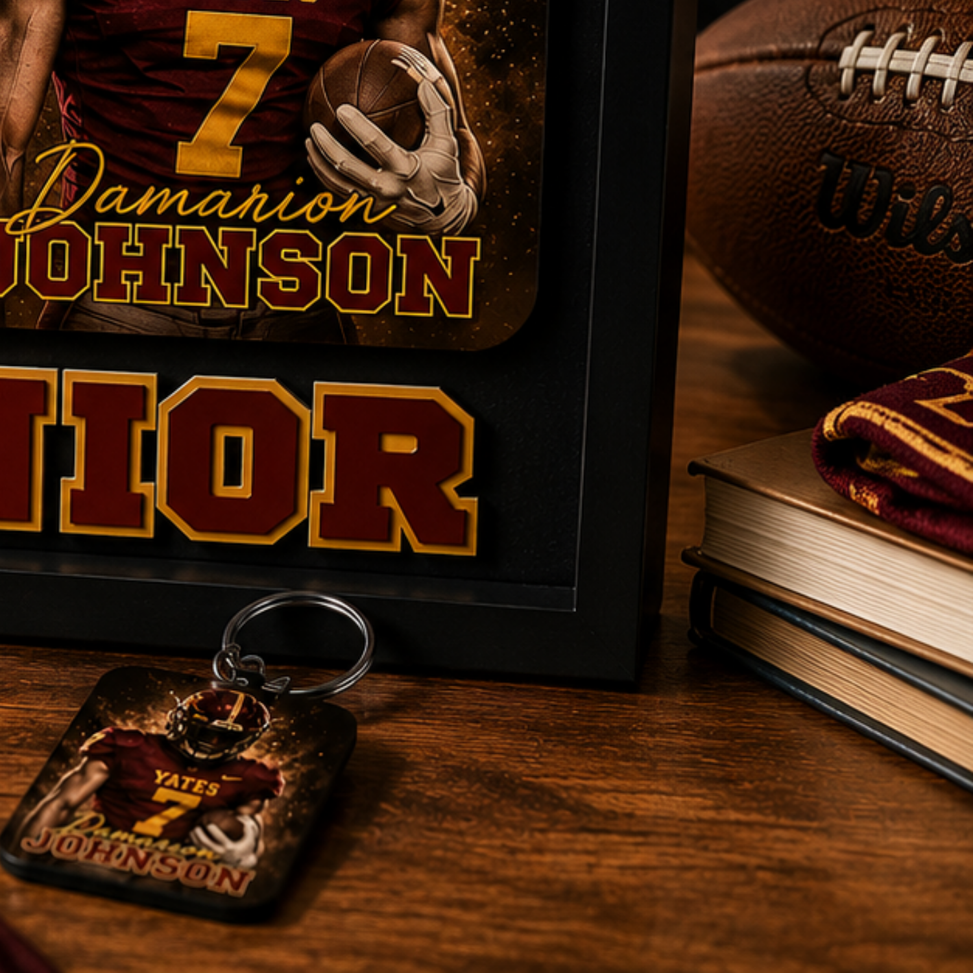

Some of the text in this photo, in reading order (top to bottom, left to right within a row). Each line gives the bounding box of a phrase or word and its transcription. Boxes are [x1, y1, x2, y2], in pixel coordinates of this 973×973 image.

[175, 10, 293, 178] 7
[5, 139, 397, 236] Damarion
[132, 787, 202, 837] 7
[154, 769, 221, 797] YATES
[20, 826, 257, 898] JOHNSON
